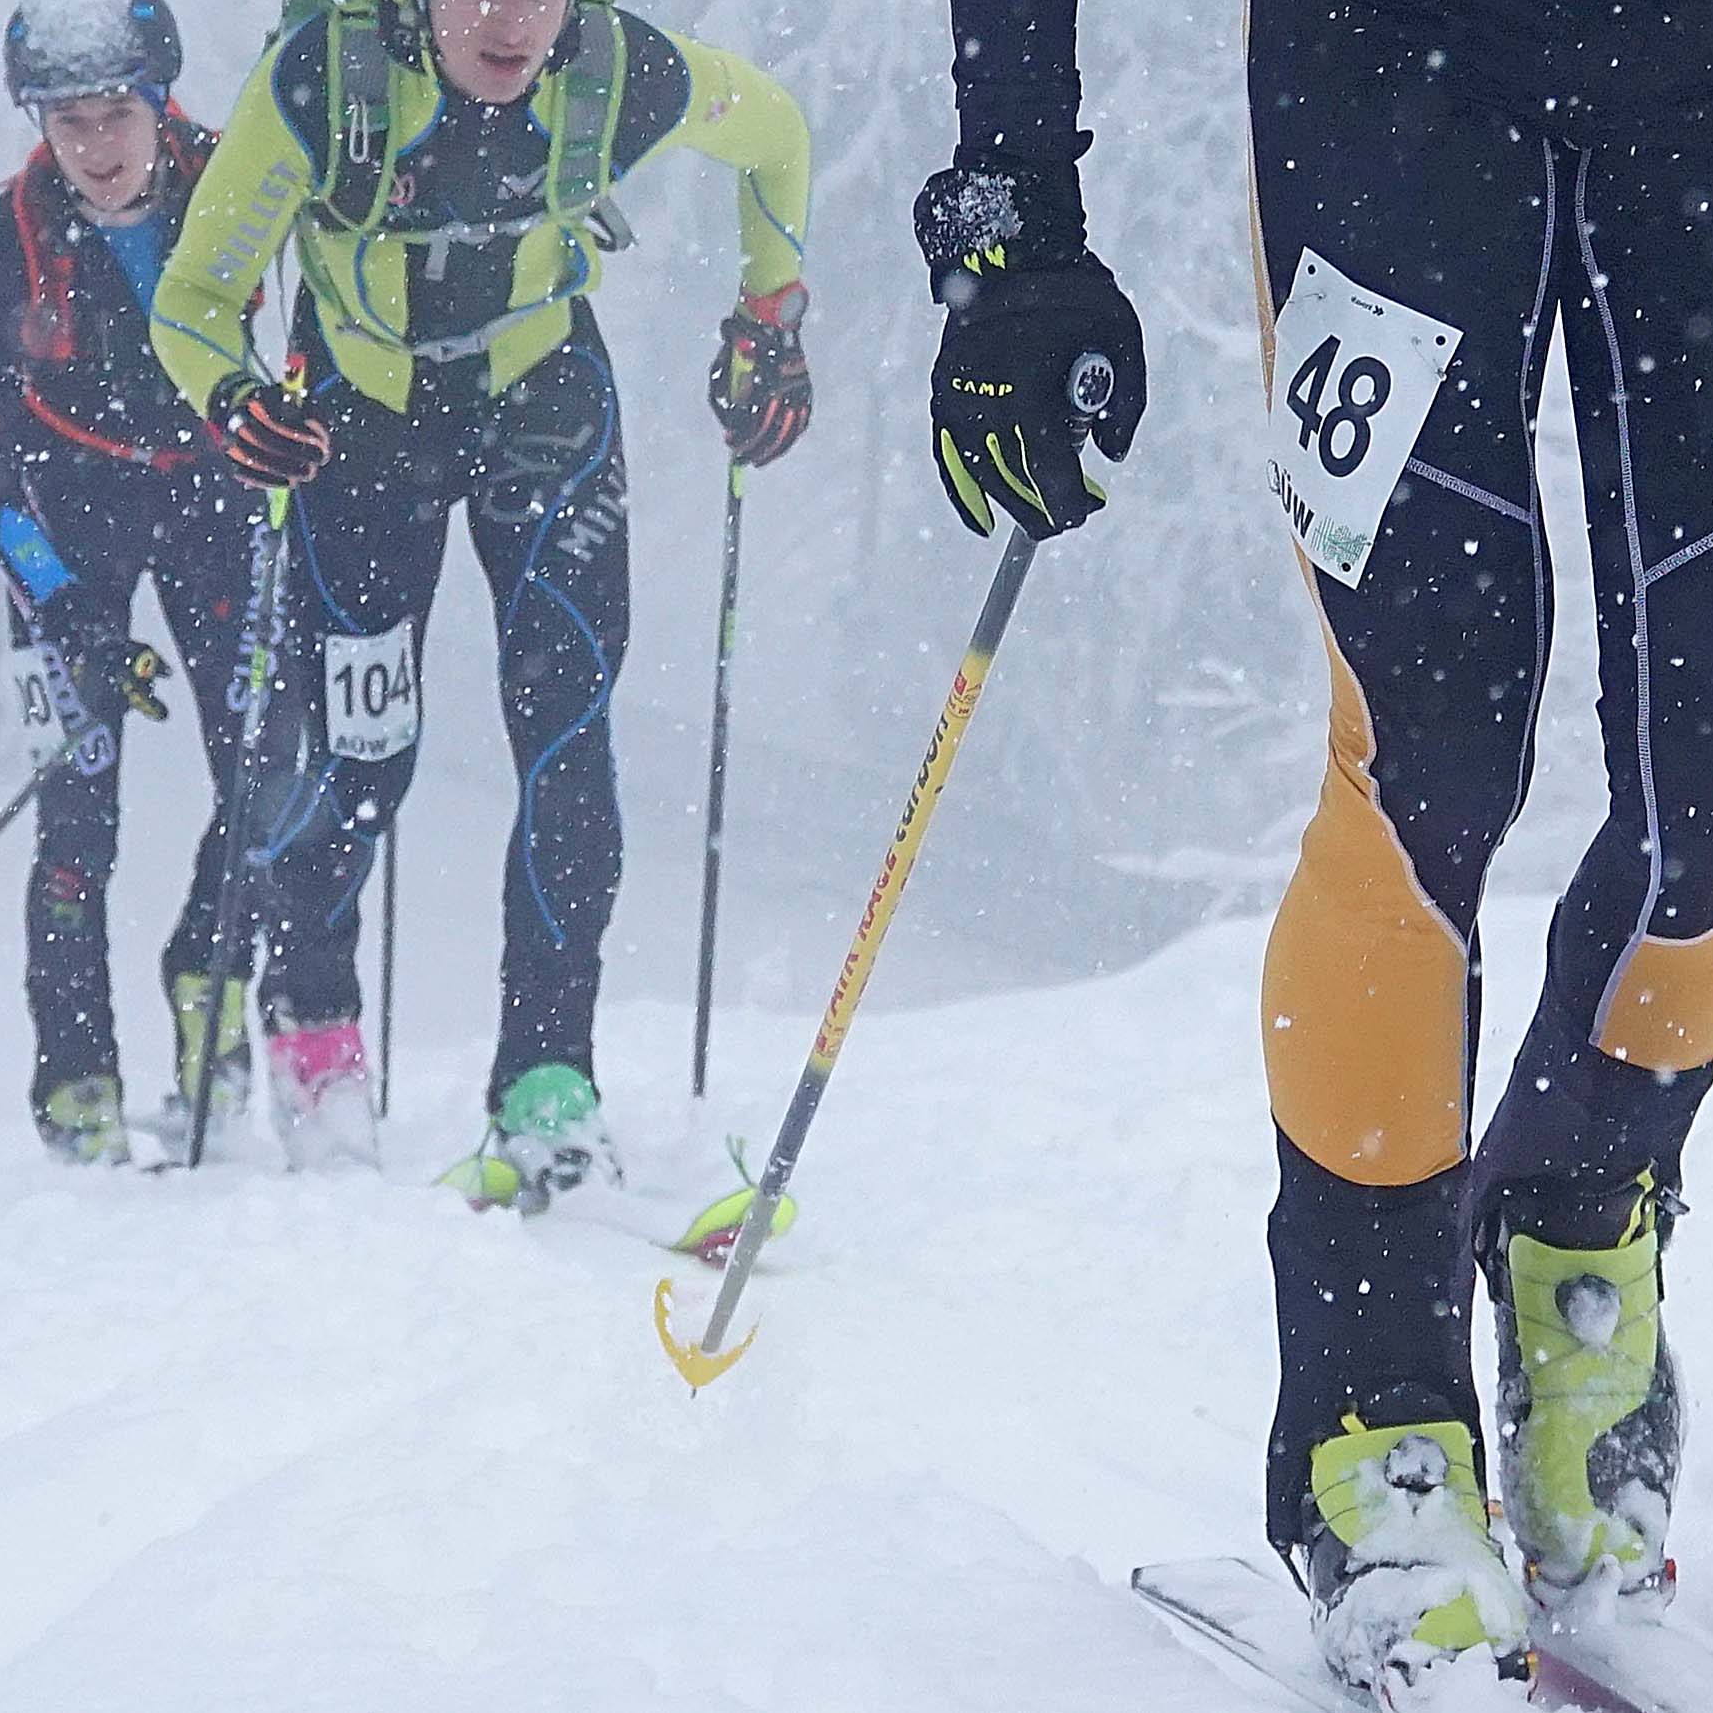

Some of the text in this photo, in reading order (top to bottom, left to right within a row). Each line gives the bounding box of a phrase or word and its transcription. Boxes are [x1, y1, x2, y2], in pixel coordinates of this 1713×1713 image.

[207, 159, 299, 285] MILLET
[952, 377, 1014, 397] CAMP
[1287, 334, 1392, 477] 48
[334, 647, 411, 718] 104
